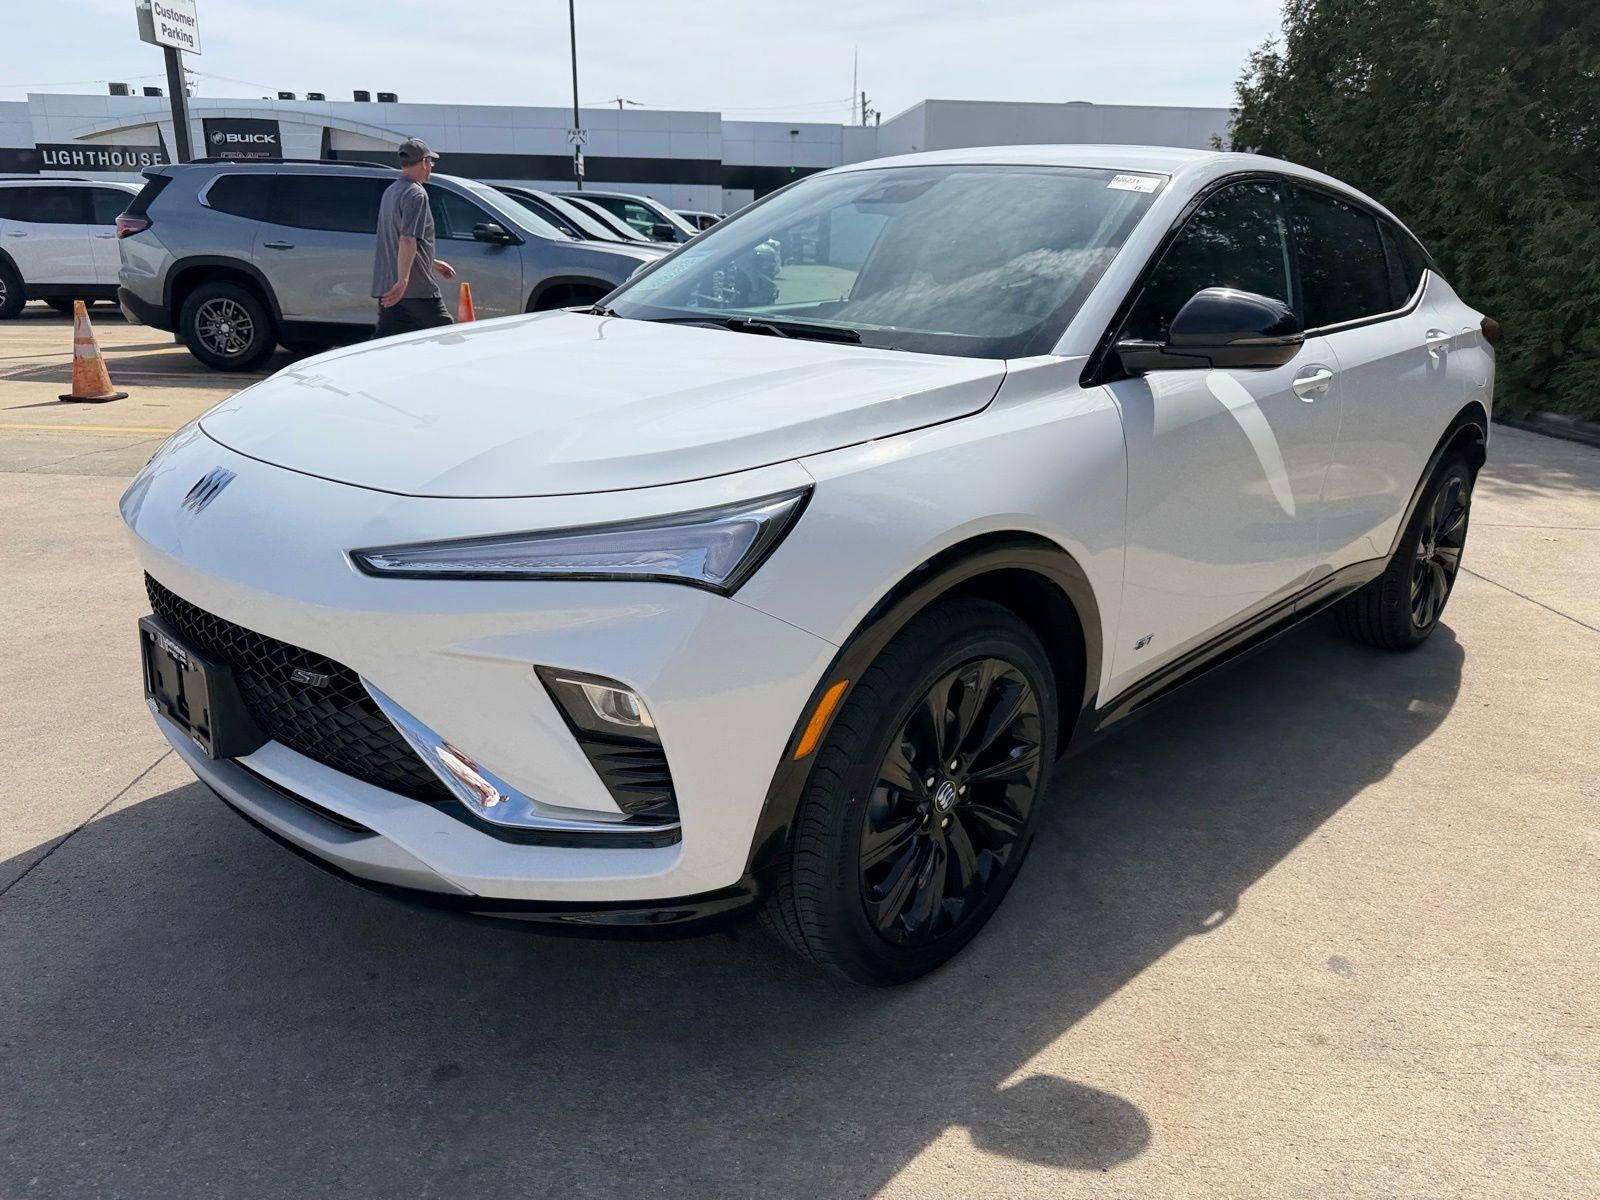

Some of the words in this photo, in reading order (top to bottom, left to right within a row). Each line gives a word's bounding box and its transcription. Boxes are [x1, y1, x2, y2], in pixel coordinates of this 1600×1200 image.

[154, 2, 195, 27] Customer
[161, 23, 194, 47] Parking
[226, 133, 277, 143] BUICK
[43, 150, 162, 166] LIGHTHOUSE
[1133, 633, 1154, 650] ST
[291, 668, 329, 688] ST
